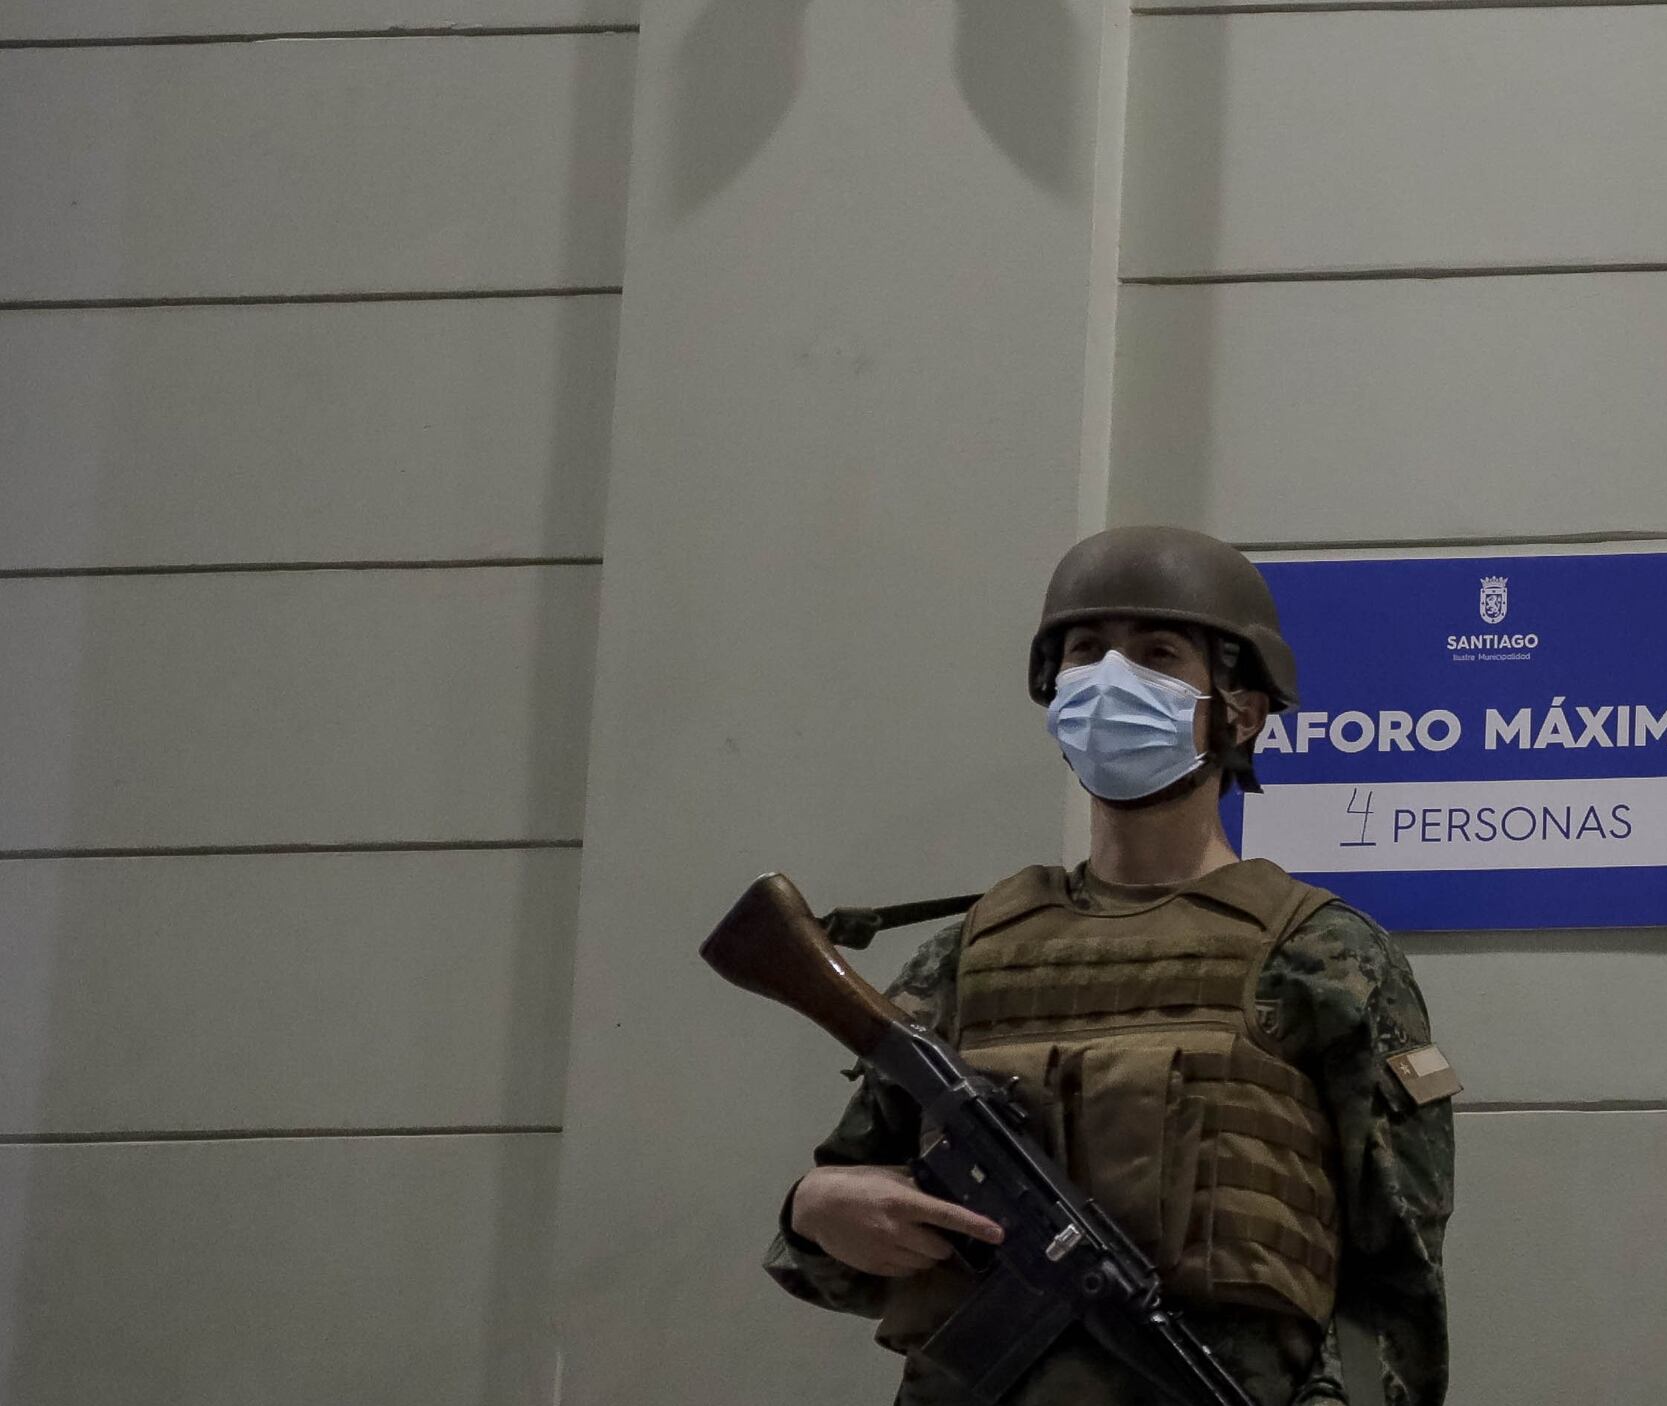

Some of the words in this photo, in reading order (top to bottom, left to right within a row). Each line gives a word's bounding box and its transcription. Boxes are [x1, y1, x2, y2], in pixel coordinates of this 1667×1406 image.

[1447, 633, 1539, 650] SANTIAGO
[1254, 709, 1461, 754] AFORO
[1347, 788, 1374, 844] 4
[1393, 804, 1633, 844] PERSONAS
